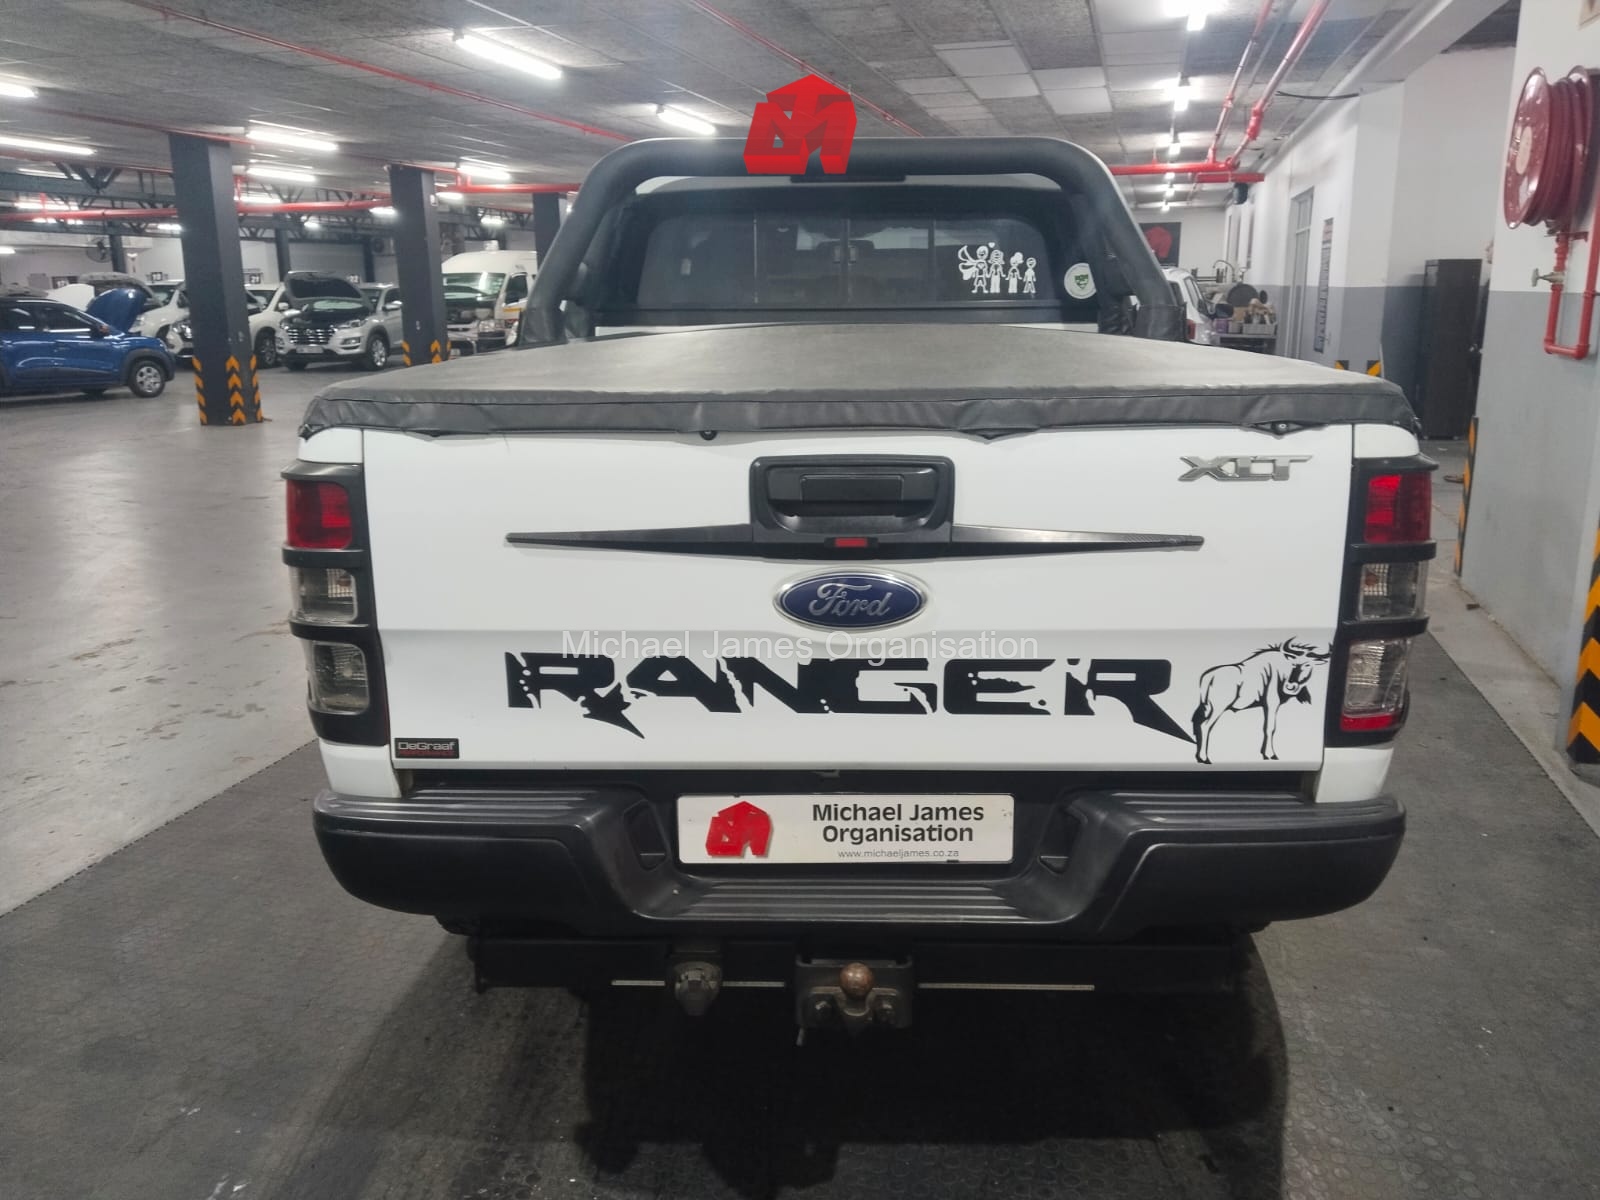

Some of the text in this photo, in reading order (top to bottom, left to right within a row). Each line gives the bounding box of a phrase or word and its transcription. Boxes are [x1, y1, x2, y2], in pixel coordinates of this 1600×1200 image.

[1177, 455, 1313, 482] XLT
[808, 583, 893, 617] Ford
[504, 651, 1198, 745] RANGER
[398, 741, 456, 751] DeGraaf
[812, 803, 985, 822] Michael James
[822, 824, 974, 846] Organisation
[838, 849, 960, 859] www.michaeljames.co.za
